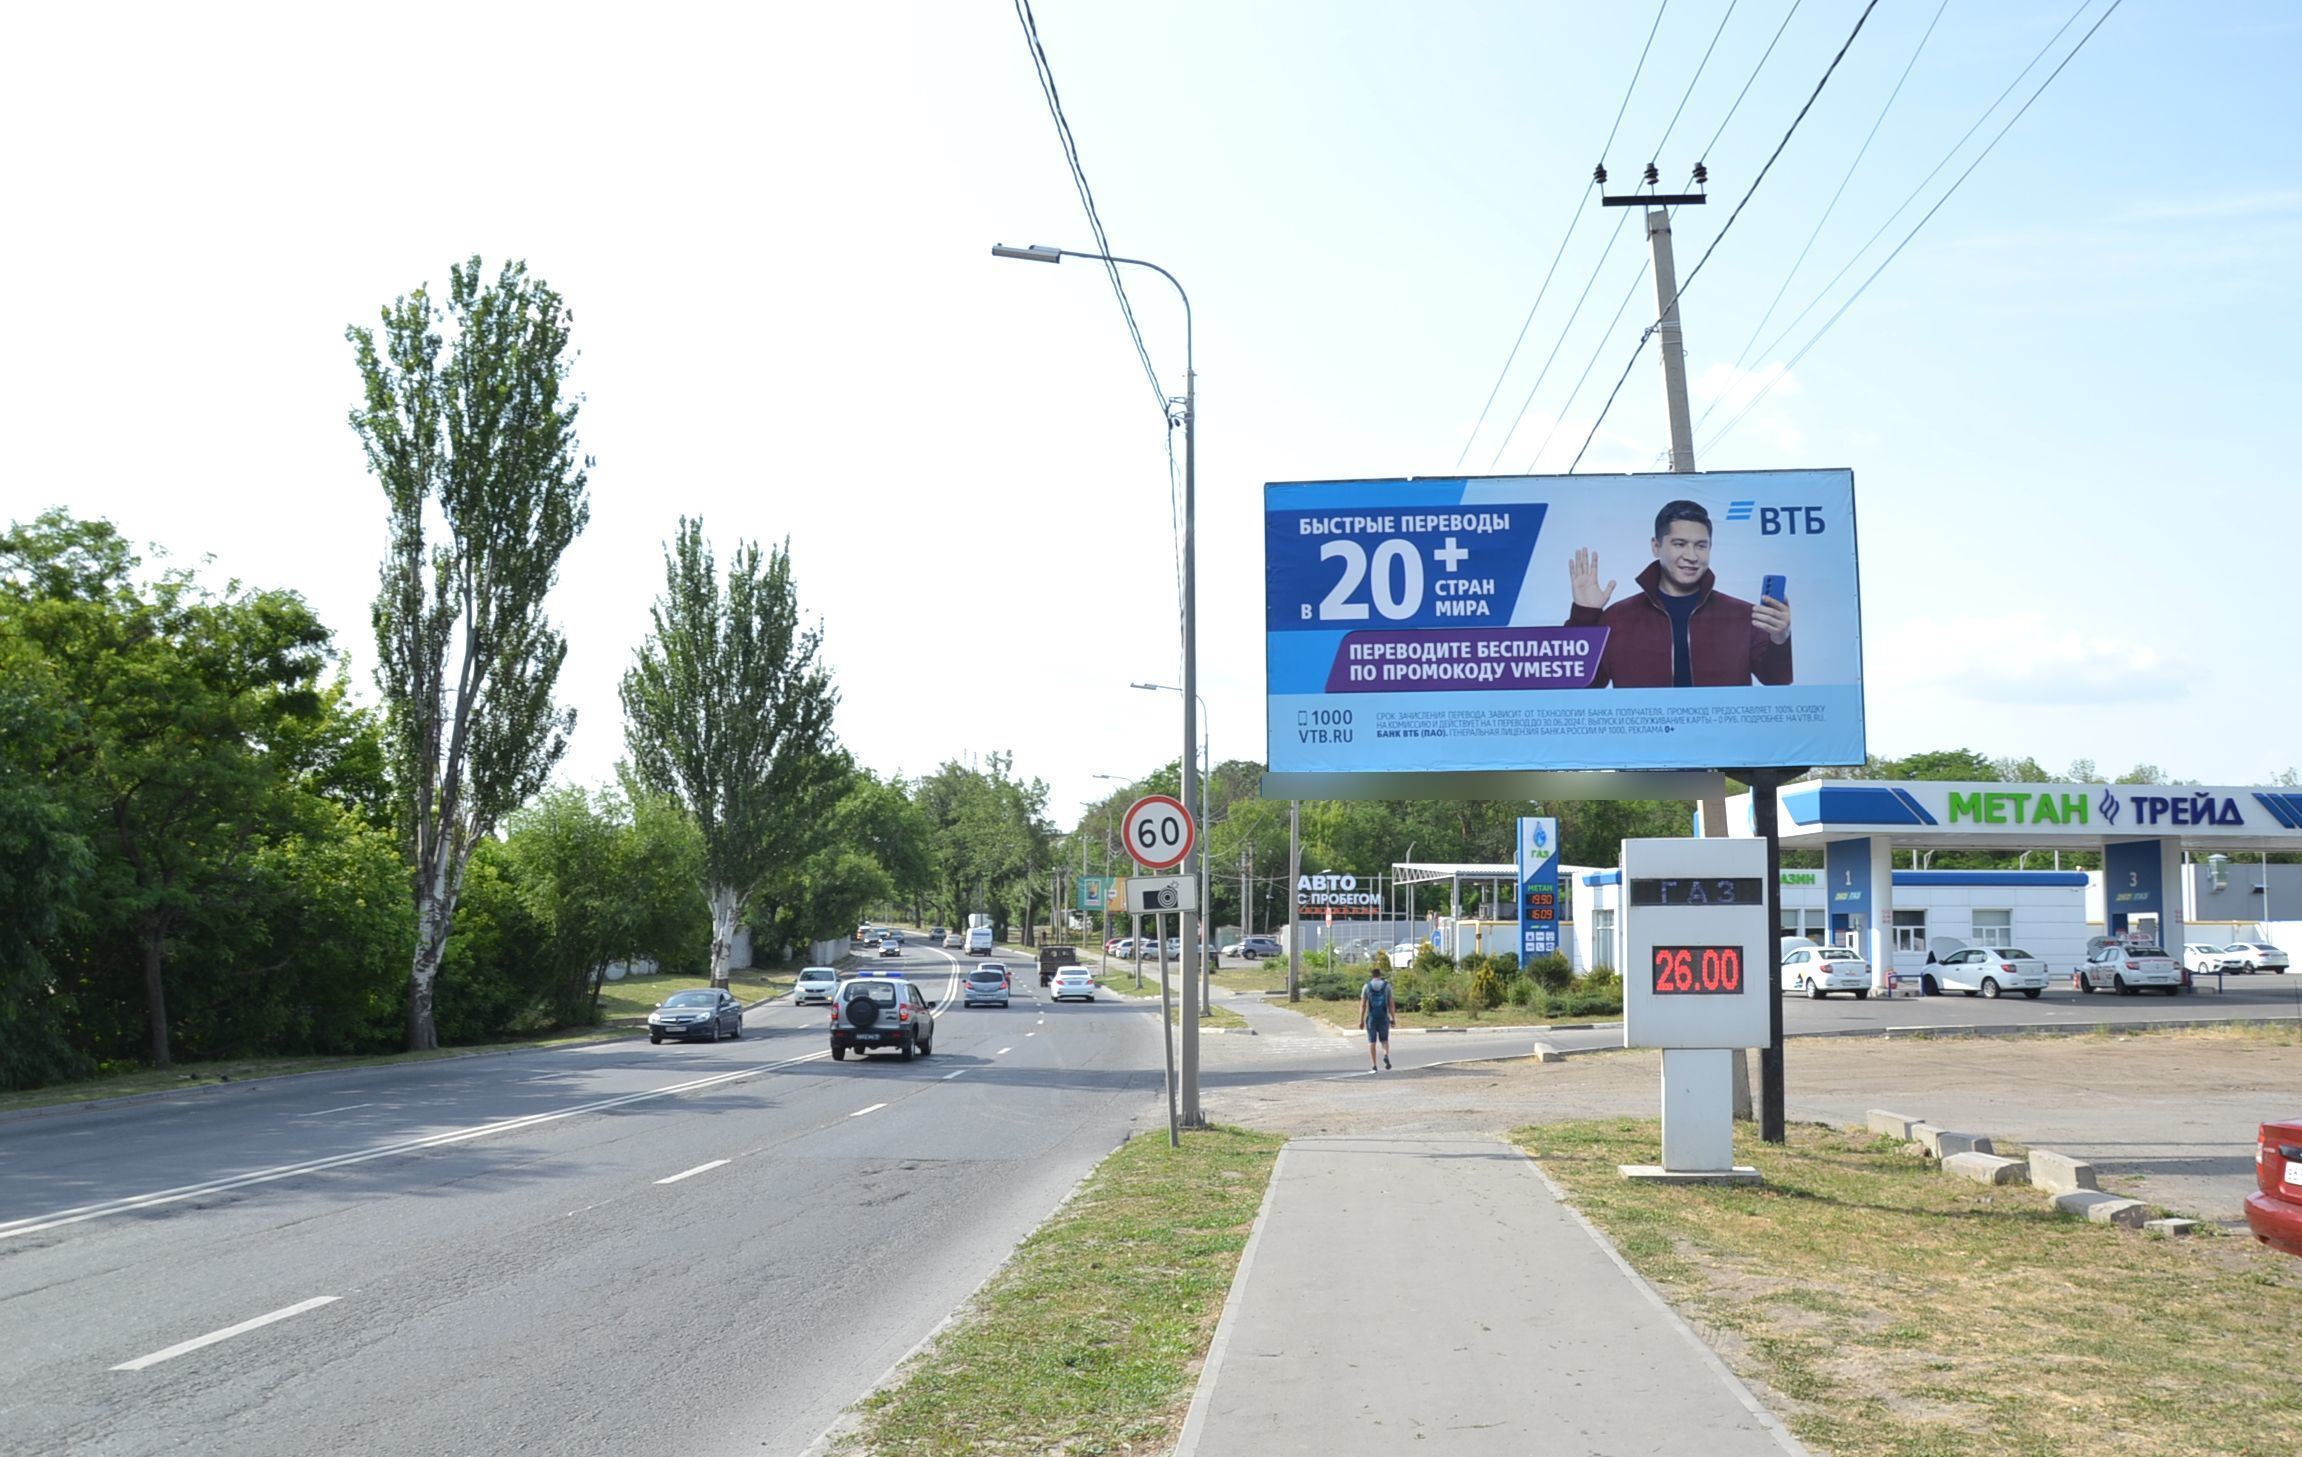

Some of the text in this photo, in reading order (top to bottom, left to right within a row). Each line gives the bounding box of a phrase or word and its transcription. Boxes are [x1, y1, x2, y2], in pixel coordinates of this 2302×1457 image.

[1300, 513, 1510, 535] БЫСТРЫЕ ПЕРЕВОДЫ
[1760, 506, 1825, 535] ВТБ
[1435, 579, 1495, 596] СТРАН
[1435, 600, 1490, 617] МИРА
[1349, 639, 1590, 662] ПЕРЕВОДИТЕ БЕСПЛАТНО
[1349, 660, 1585, 682] ПО ПРОМОКОДУ VMESTE
[1311, 709, 1353, 726] 1000
[1298, 728, 1353, 744] VTB.RU
[1377, 730, 1400, 738] БАНК
[1403, 729, 1419, 738] ВТБ
[1948, 791, 2245, 826] МЕТАН ТРЕЙД
[1138, 816, 1179, 848] 60
[1531, 849, 1550, 858] ГАЗ
[1297, 875, 1357, 891] АВТО
[1779, 873, 1816, 885] АЗИН
[1845, 870, 1852, 886] 1
[2129, 872, 2137, 887] 3
[1297, 893, 1381, 905] С ПРОБЕГОМ
[1661, 880, 1735, 904] ГАЗ
[1655, 948, 1739, 991] 26.00
